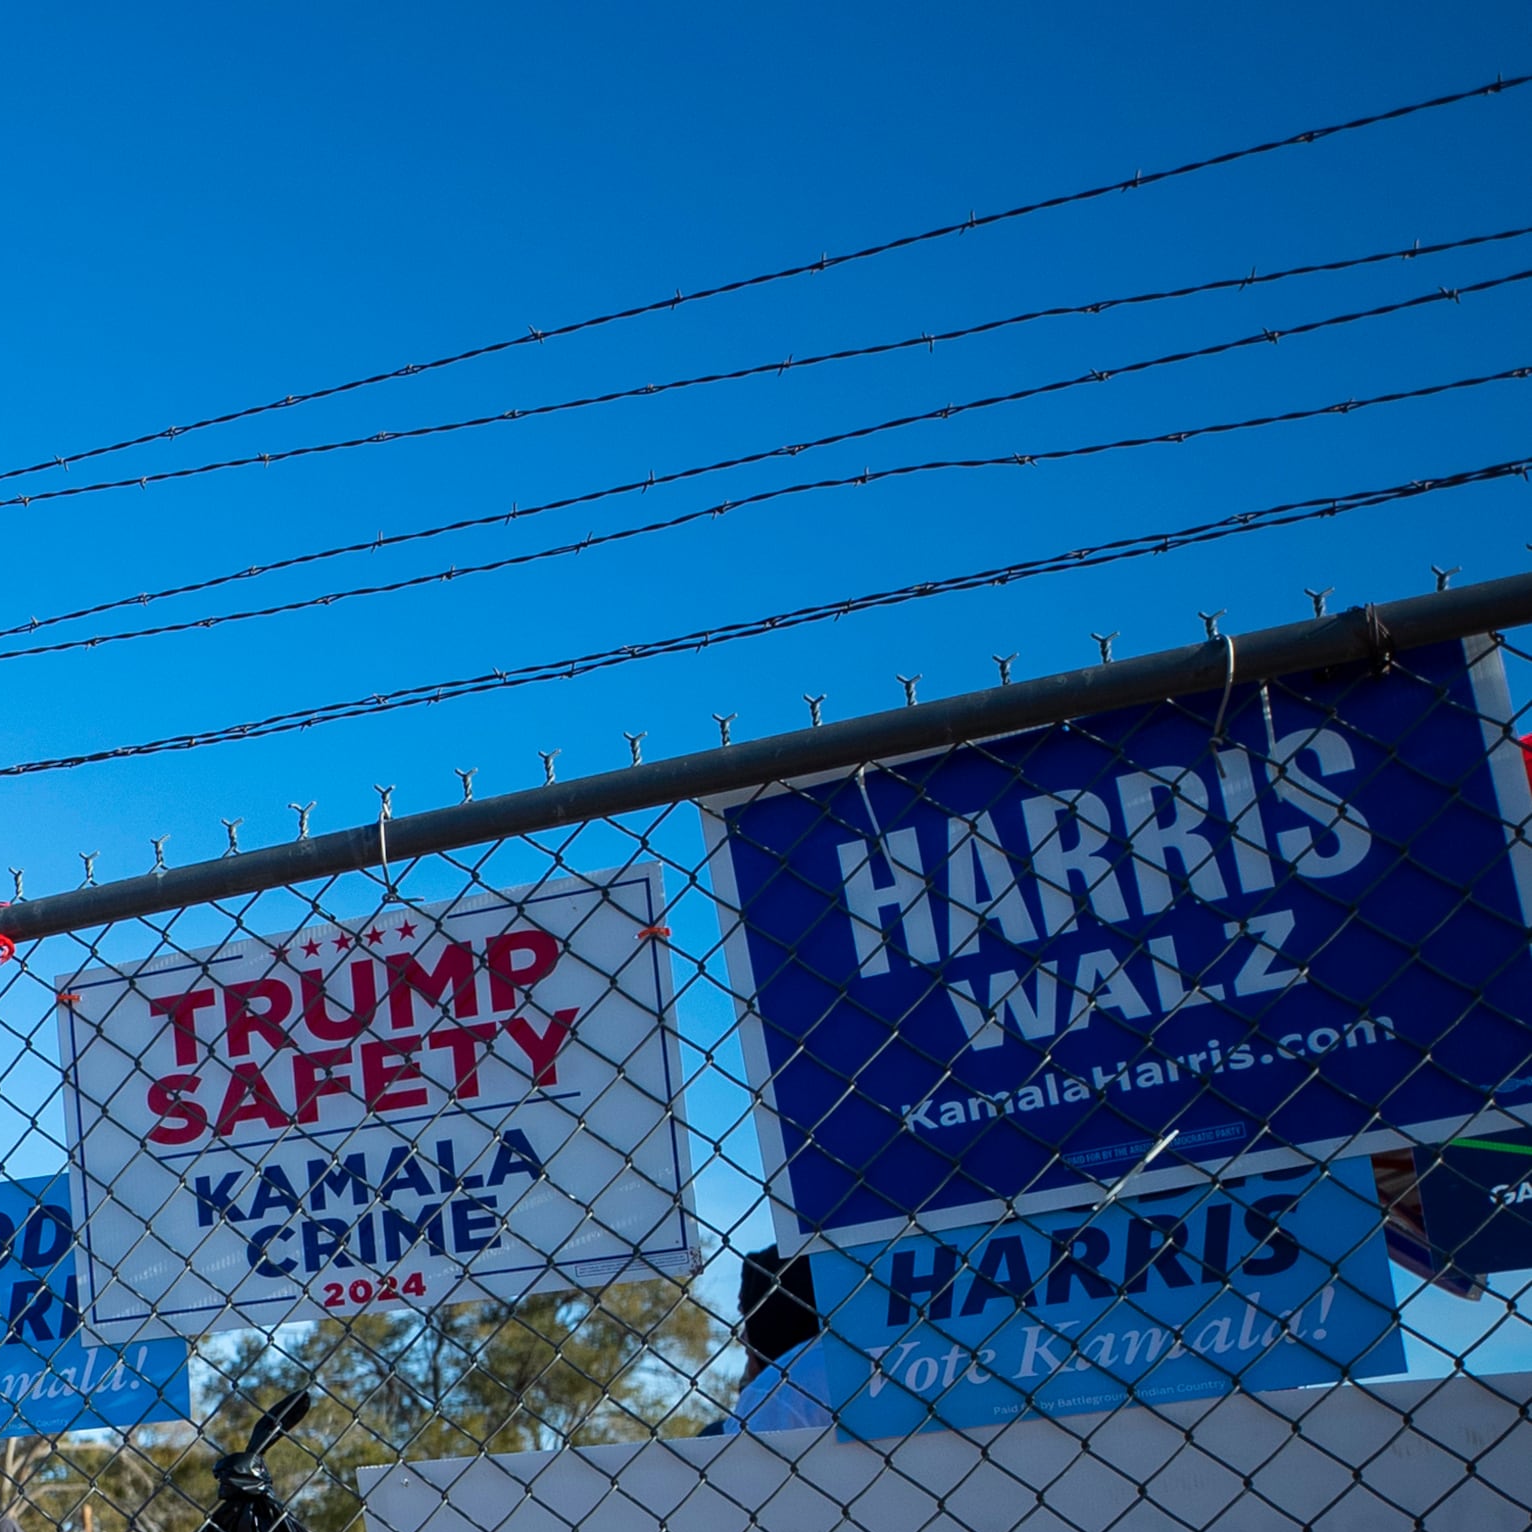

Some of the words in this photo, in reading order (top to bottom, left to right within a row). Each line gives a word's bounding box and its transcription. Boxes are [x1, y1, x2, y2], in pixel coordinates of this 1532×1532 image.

[837, 728, 1371, 978] HARRIS
[150, 929, 559, 1067] TRUMP
[950, 909, 1309, 1052] WALZ
[145, 1006, 579, 1145] SAFETY
[901, 1011, 1397, 1134] KamalaHarris.com
[195, 1128, 542, 1227] KAMALA
[1086, 1152, 1101, 1162] FOR
[1103, 1150, 1113, 1159] BY
[1115, 1147, 1128, 1158] THE
[1216, 1126, 1241, 1139] PARTY
[247, 1195, 502, 1278] CRIME
[323, 1273, 427, 1307] 2024
[887, 1194, 1299, 1327] HARRIS
[864, 1341, 997, 1398] Vote
[1014, 1287, 1335, 1382] Kamala!
[994, 1404, 1018, 1415] Paid
[1040, 1399, 1054, 1410] by
[1057, 1391, 1133, 1409] Battlegroun
[1136, 1386, 1175, 1398] Indian
[1176, 1378, 1226, 1393] Country
